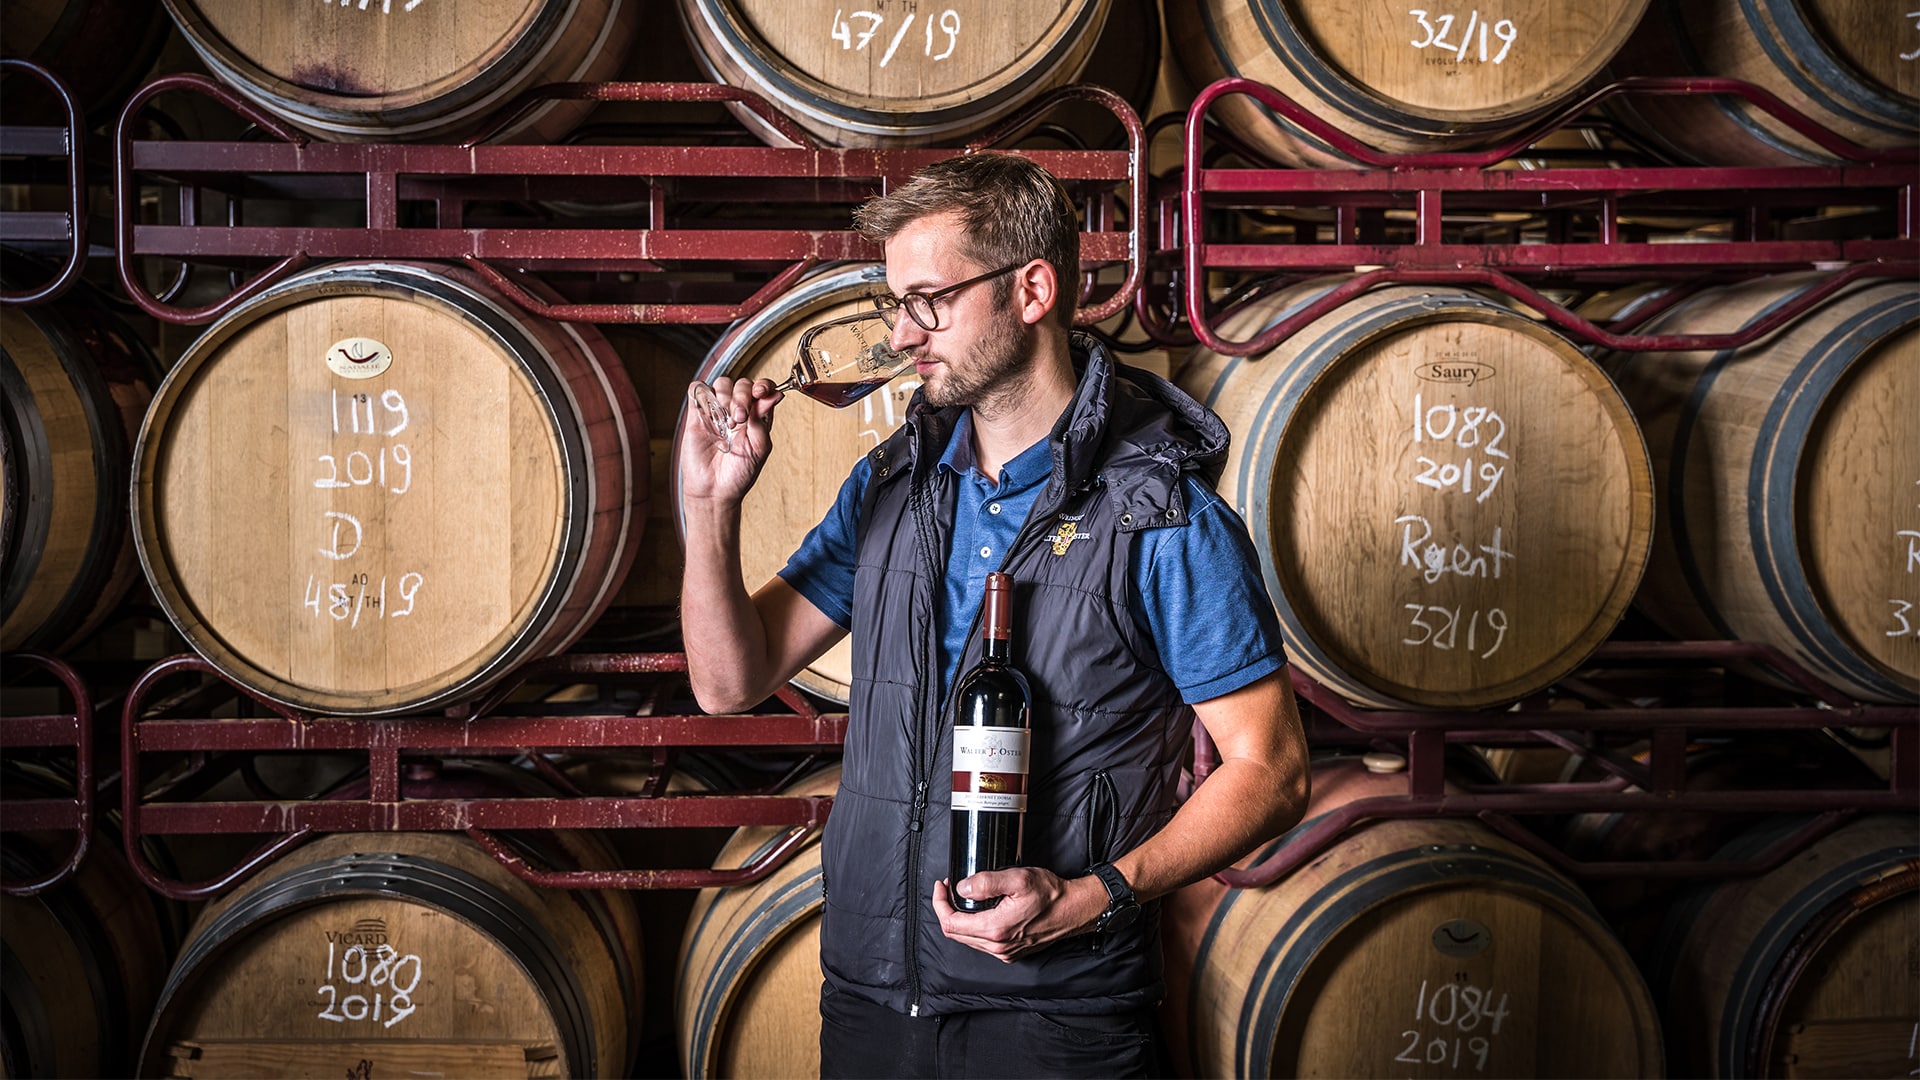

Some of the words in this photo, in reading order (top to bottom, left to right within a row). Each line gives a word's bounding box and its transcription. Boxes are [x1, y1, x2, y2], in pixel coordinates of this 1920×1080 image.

[831, 9, 960, 67] 47/19
[1409, 9, 1517, 64] 32/19
[1425, 58, 1474, 66] EVOLUTON
[891, 391, 905, 401] 13
[1431, 364, 1480, 387] Saury
[332, 388, 409, 437] 1119
[1414, 393, 1510, 459] 1082
[313, 444, 411, 494] 2019
[1414, 456, 1504, 504] 2019
[318, 511, 362, 560] D
[304, 572, 423, 629] 48/19
[325, 931, 388, 945] VICARD
[327, 944, 422, 995] 1080
[317, 985, 416, 1029] 2019
[1416, 979, 1511, 1036] 1084
[1395, 1029, 1489, 1072] 2019
